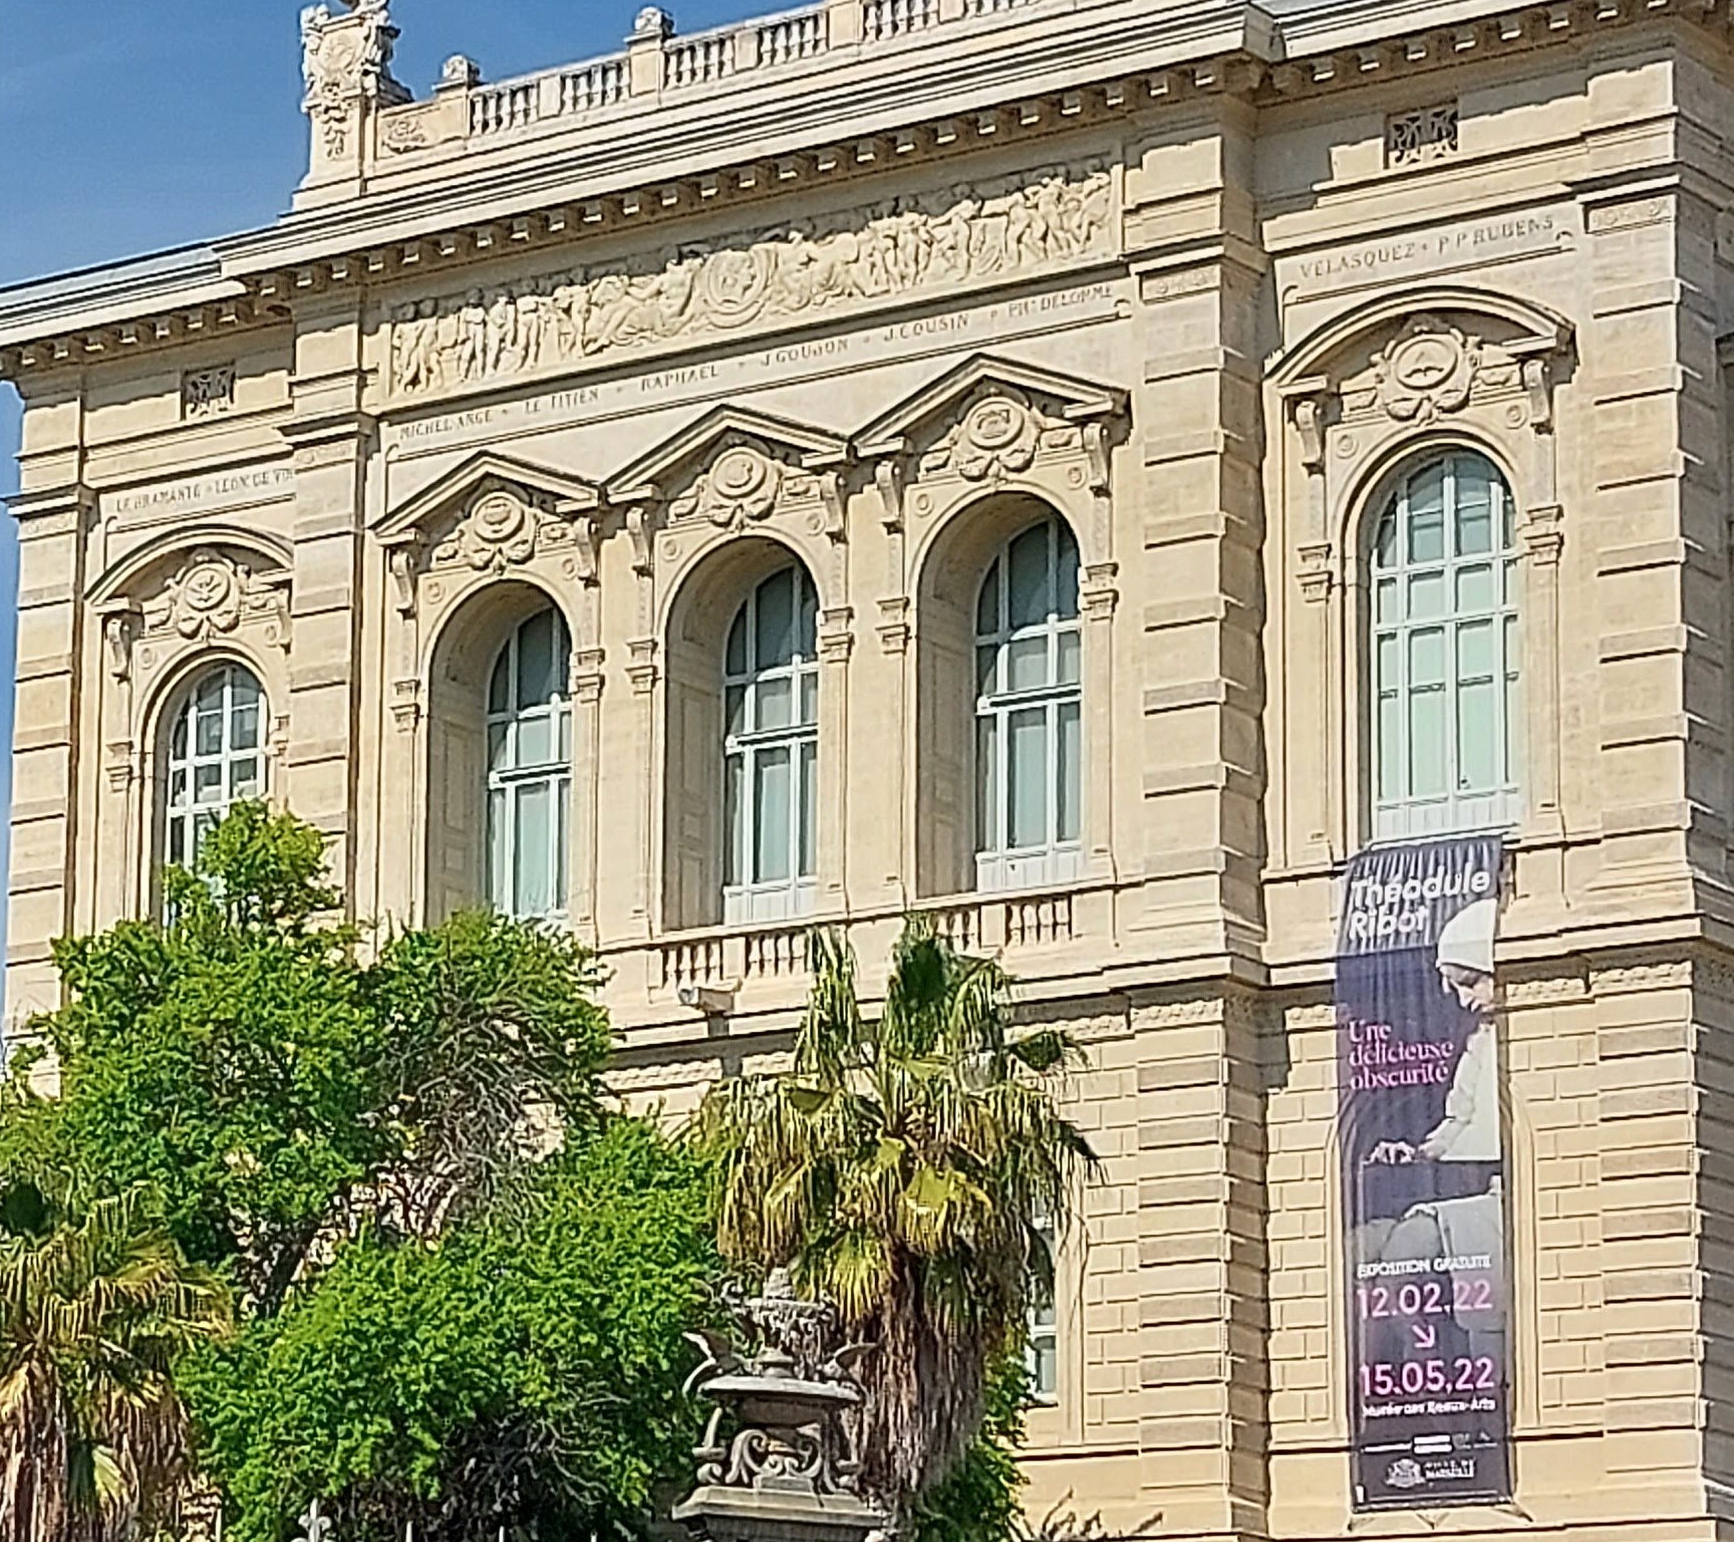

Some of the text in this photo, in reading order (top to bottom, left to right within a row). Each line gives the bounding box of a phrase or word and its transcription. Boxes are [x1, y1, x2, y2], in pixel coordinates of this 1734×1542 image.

[1299, 242, 1415, 278] VELASQUEZ
[640, 364, 720, 392] RAPHAEL
[1350, 862, 1491, 908] Théodule
[1349, 905, 1430, 941] Ribot
[1349, 1018, 1392, 1043] Une
[1349, 1038, 1455, 1067] délicieuse
[1350, 1060, 1450, 1091] obscurité
[1357, 1278, 1494, 1320] 12.02.22
[1360, 1357, 1495, 1396] 15.05.22
